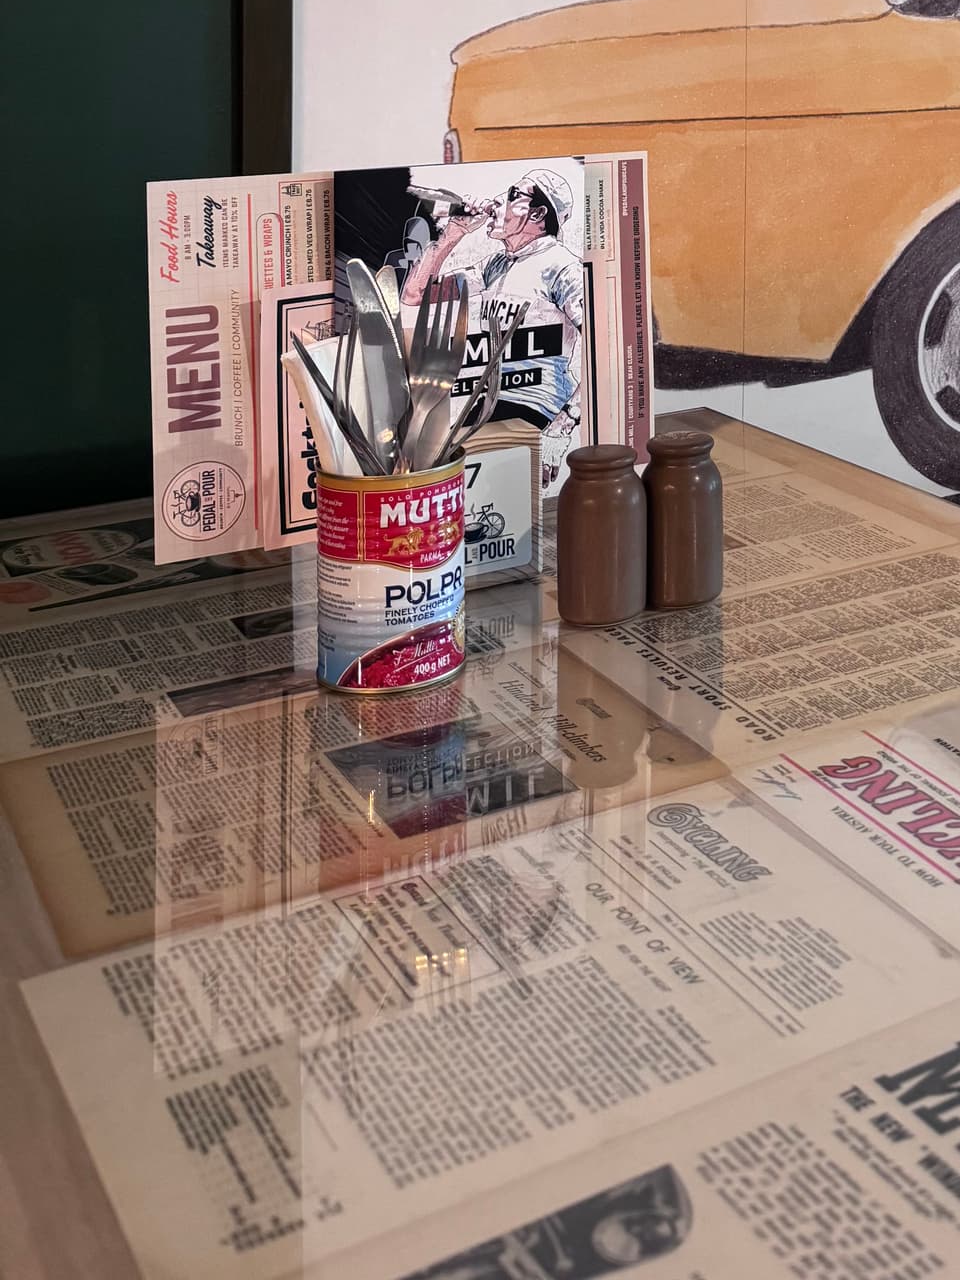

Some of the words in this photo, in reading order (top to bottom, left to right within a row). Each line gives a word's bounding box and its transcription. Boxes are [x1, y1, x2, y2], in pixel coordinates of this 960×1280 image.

[159, 190, 178, 239] Hours
[305, 211, 313, 232] WRAP
[194, 194, 222, 269] Takeaway
[263, 218, 272, 246] WRAPS
[284, 228, 292, 257] CRUNCH
[160, 242, 179, 283] Food
[231, 233, 240, 268] TAKEAWAY
[231, 289, 241, 351] COMMUNITY
[166, 304, 222, 434] MENU
[233, 359, 242, 400] COFFEE
[234, 403, 243, 447] BRUNCH
[201, 469, 214, 495] POUR
[380, 494, 411, 503] SOLO
[380, 485, 464, 529] MUTTI
[202, 500, 215, 531] PEDAL
[420, 552, 442, 564] PARMA
[480, 538, 515, 562] POUR
[384, 566, 462, 609] POLPA
[385, 606, 418, 618] FINELY
[385, 611, 435, 626] TOMATOES
[603, 627, 635, 646] PAGE
[414, 659, 430, 675] 400
[438, 653, 450, 668] NET
[636, 648, 688, 681] RESULTS
[679, 681, 735, 713] SPORT
[735, 714, 777, 743] ROAD
[829, 805, 872, 833] AUSTRIA
[647, 802, 773, 883] CYCLING
[867, 833, 900, 854] TOUR
[895, 854, 917, 867] TO
[911, 866, 945, 888] HOW
[583, 880, 613, 905] OUR
[609, 903, 651, 938] POINT
[646, 936, 671, 956] OF
[668, 955, 704, 987] VIEW
[839, 1085, 876, 1112] THE
[869, 1114, 916, 1142] NEW
